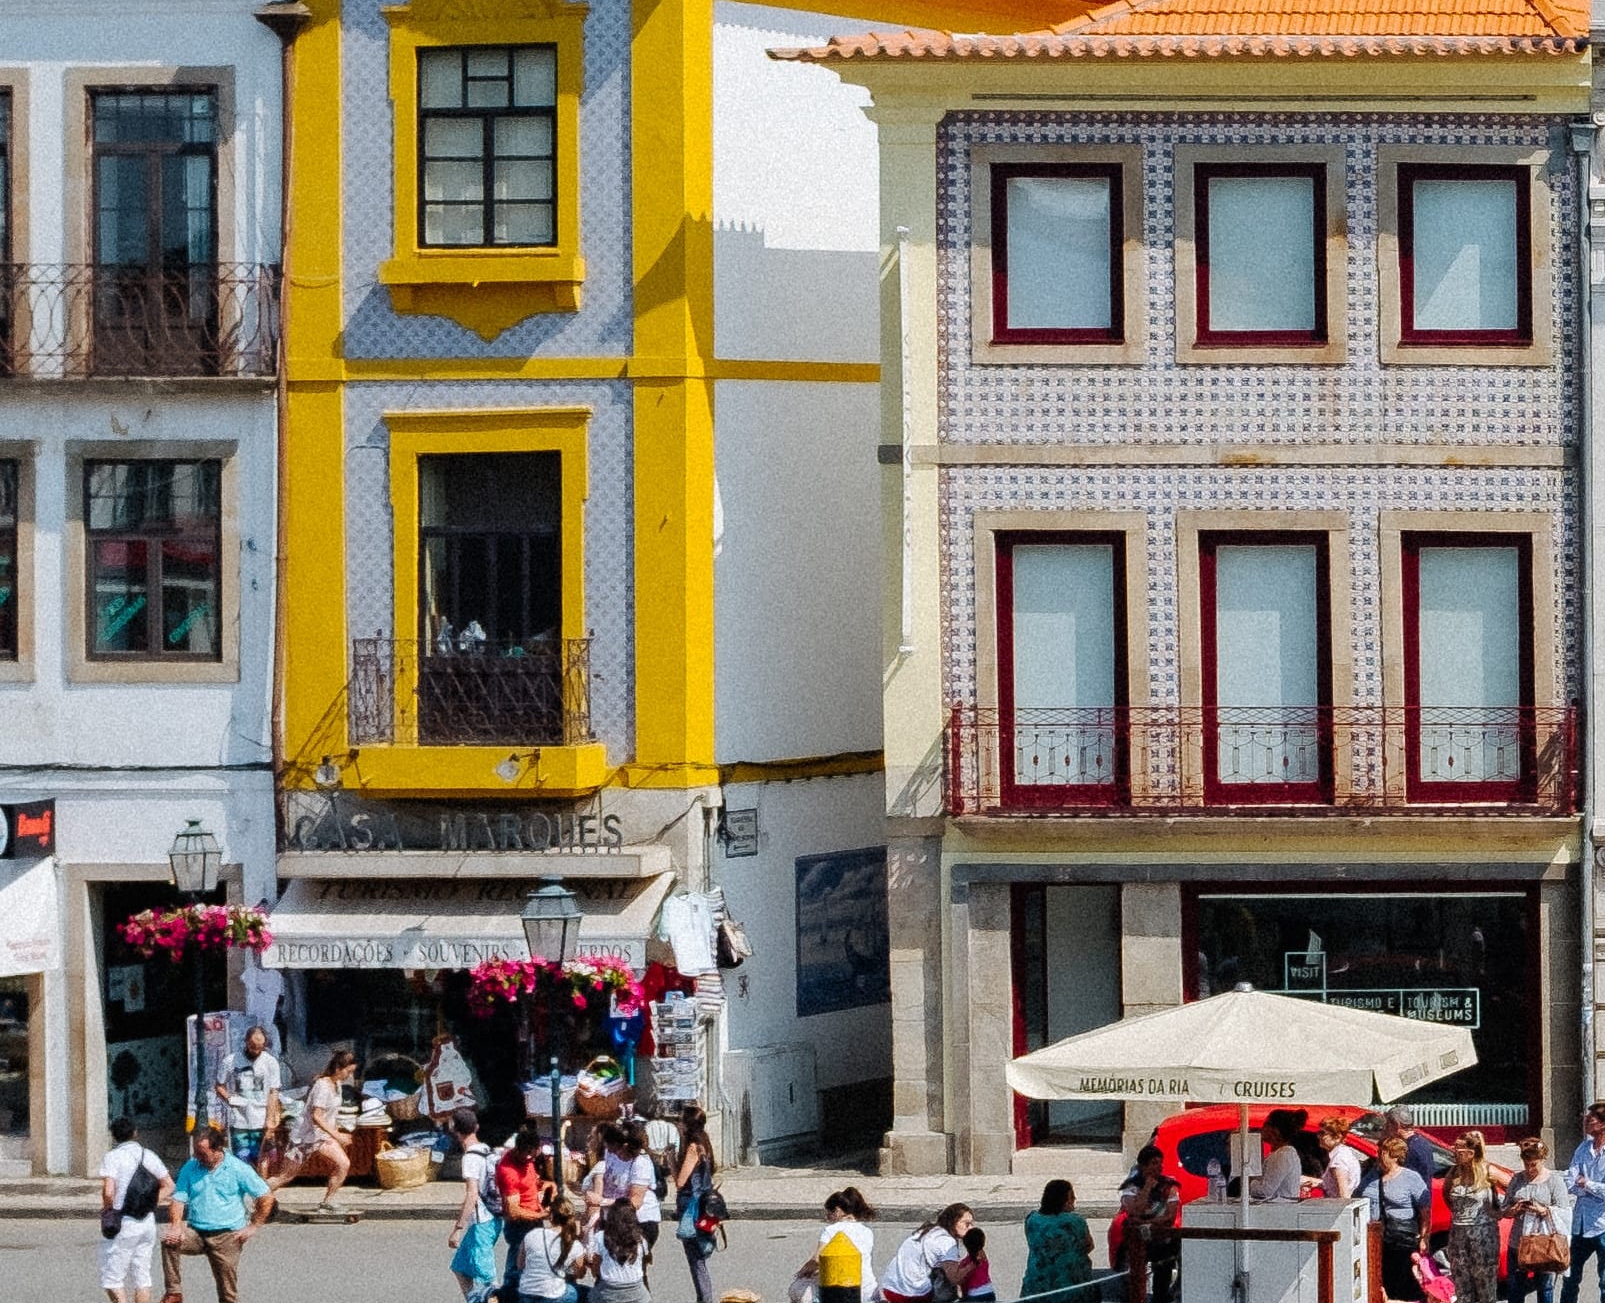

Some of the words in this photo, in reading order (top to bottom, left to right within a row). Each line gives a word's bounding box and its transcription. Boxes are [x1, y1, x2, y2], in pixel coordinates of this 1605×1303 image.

[295, 813, 403, 850] CASA
[440, 812, 622, 849] MARQUES
[277, 939, 394, 965] RECORDAÇÕES
[417, 939, 510, 963] SOUVENIRS
[1289, 966, 1321, 979] VISIT
[1463, 996, 1474, 1009] &
[1406, 1009, 1473, 1021] MUSEUMS
[1079, 1072, 1145, 1094] MEMÓRIAS
[1148, 1078, 1165, 1095] DA
[1168, 1079, 1190, 1096] RIA
[1233, 1080, 1297, 1099] CRUISES
